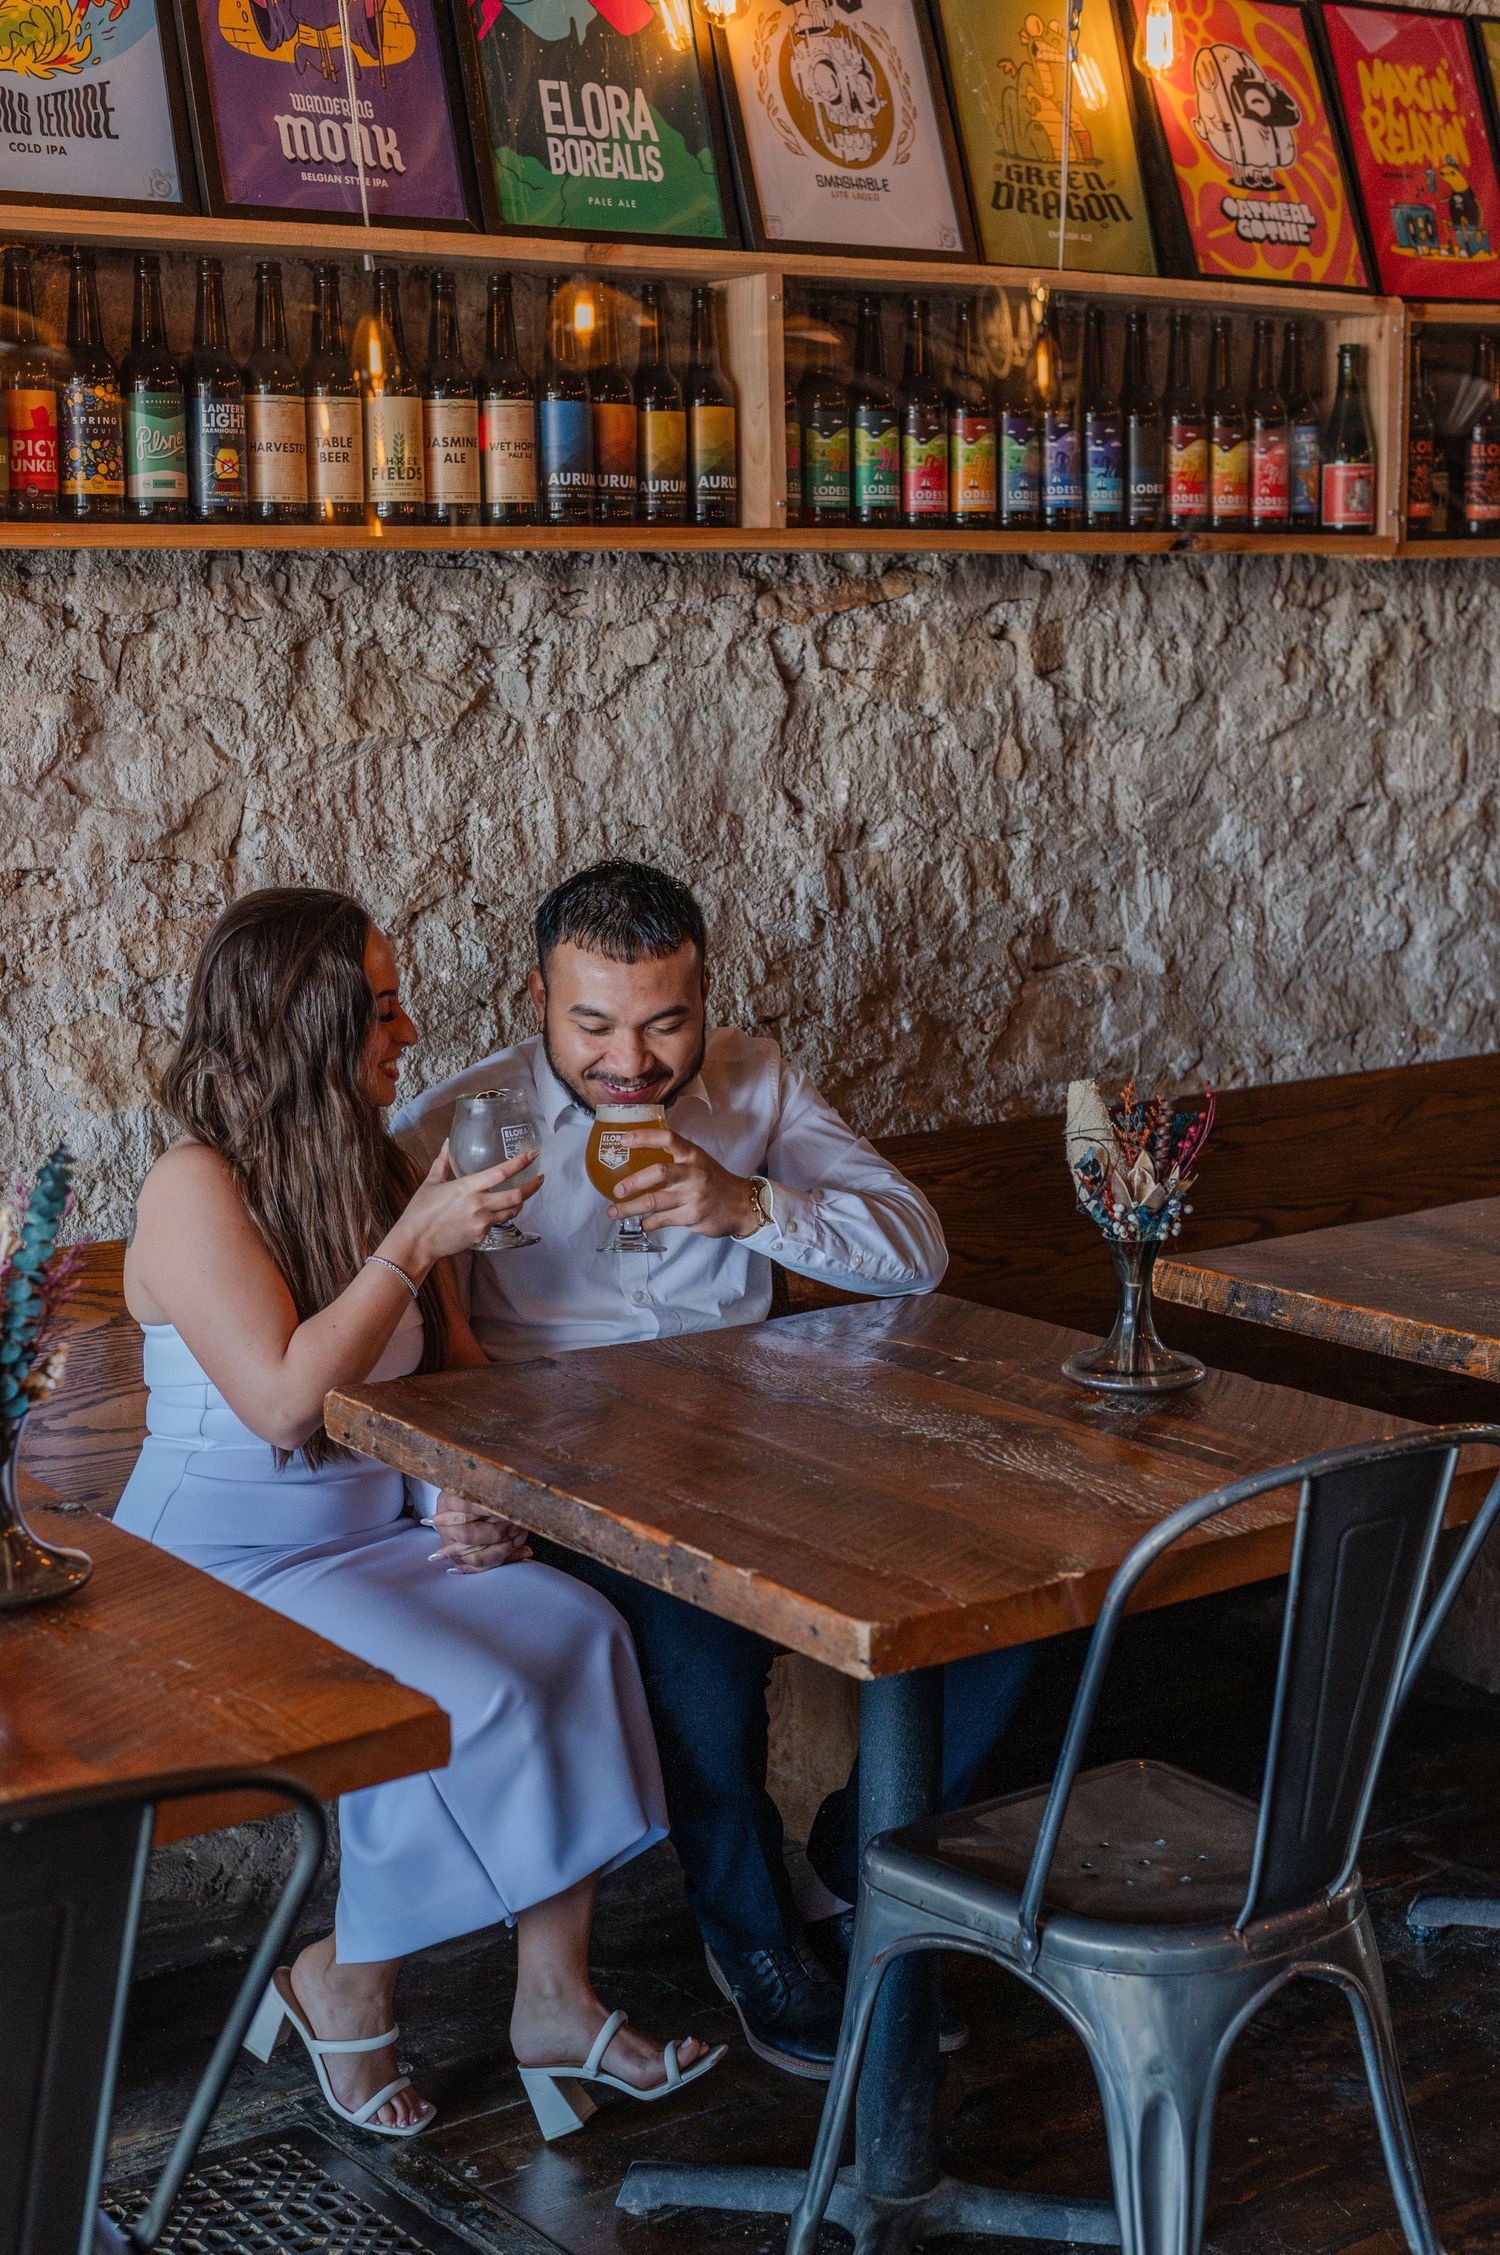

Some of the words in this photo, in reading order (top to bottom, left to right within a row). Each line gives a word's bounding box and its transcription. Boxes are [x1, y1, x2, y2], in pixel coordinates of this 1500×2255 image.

[0, 86, 32, 135] ILS
[36, 80, 119, 139] LETTUCE
[289, 92, 374, 119] WANDERNG
[538, 79, 659, 142] ELORA
[9, 142, 42, 153] COLD
[46, 145, 67, 156] IPA
[547, 137, 664, 182] BOREALIS
[301, 172, 341, 183] BELGIAN
[345, 176, 370, 186] STYE
[373, 178, 389, 188] IPA
[815, 174, 891, 192] SMASHABLE
[1005, 164, 1106, 191] GREEN
[588, 196, 613, 206] PALE
[618, 199, 637, 208] ALE
[991, 180, 1134, 223] DRAGON
[1222, 197, 1317, 226] OATMEAL
[201, 403, 245, 413] LANTERN
[72, 416, 117, 425] SPRING
[201, 413, 245, 428] LIGHT
[12, 439, 56, 457] PICY
[315, 436, 353, 448] TABLE
[425, 437, 477, 448] JASMINE
[489, 441, 511, 451] WET
[319, 452, 350, 463] BEER
[443, 453, 467, 464] ALE
[11, 459, 57, 473] UNKEL
[371, 467, 422, 480] FIELDS
[598, 474, 636, 488] URUM
[697, 475, 737, 488] AURU
[504, 1127, 529, 1138] ELORA
